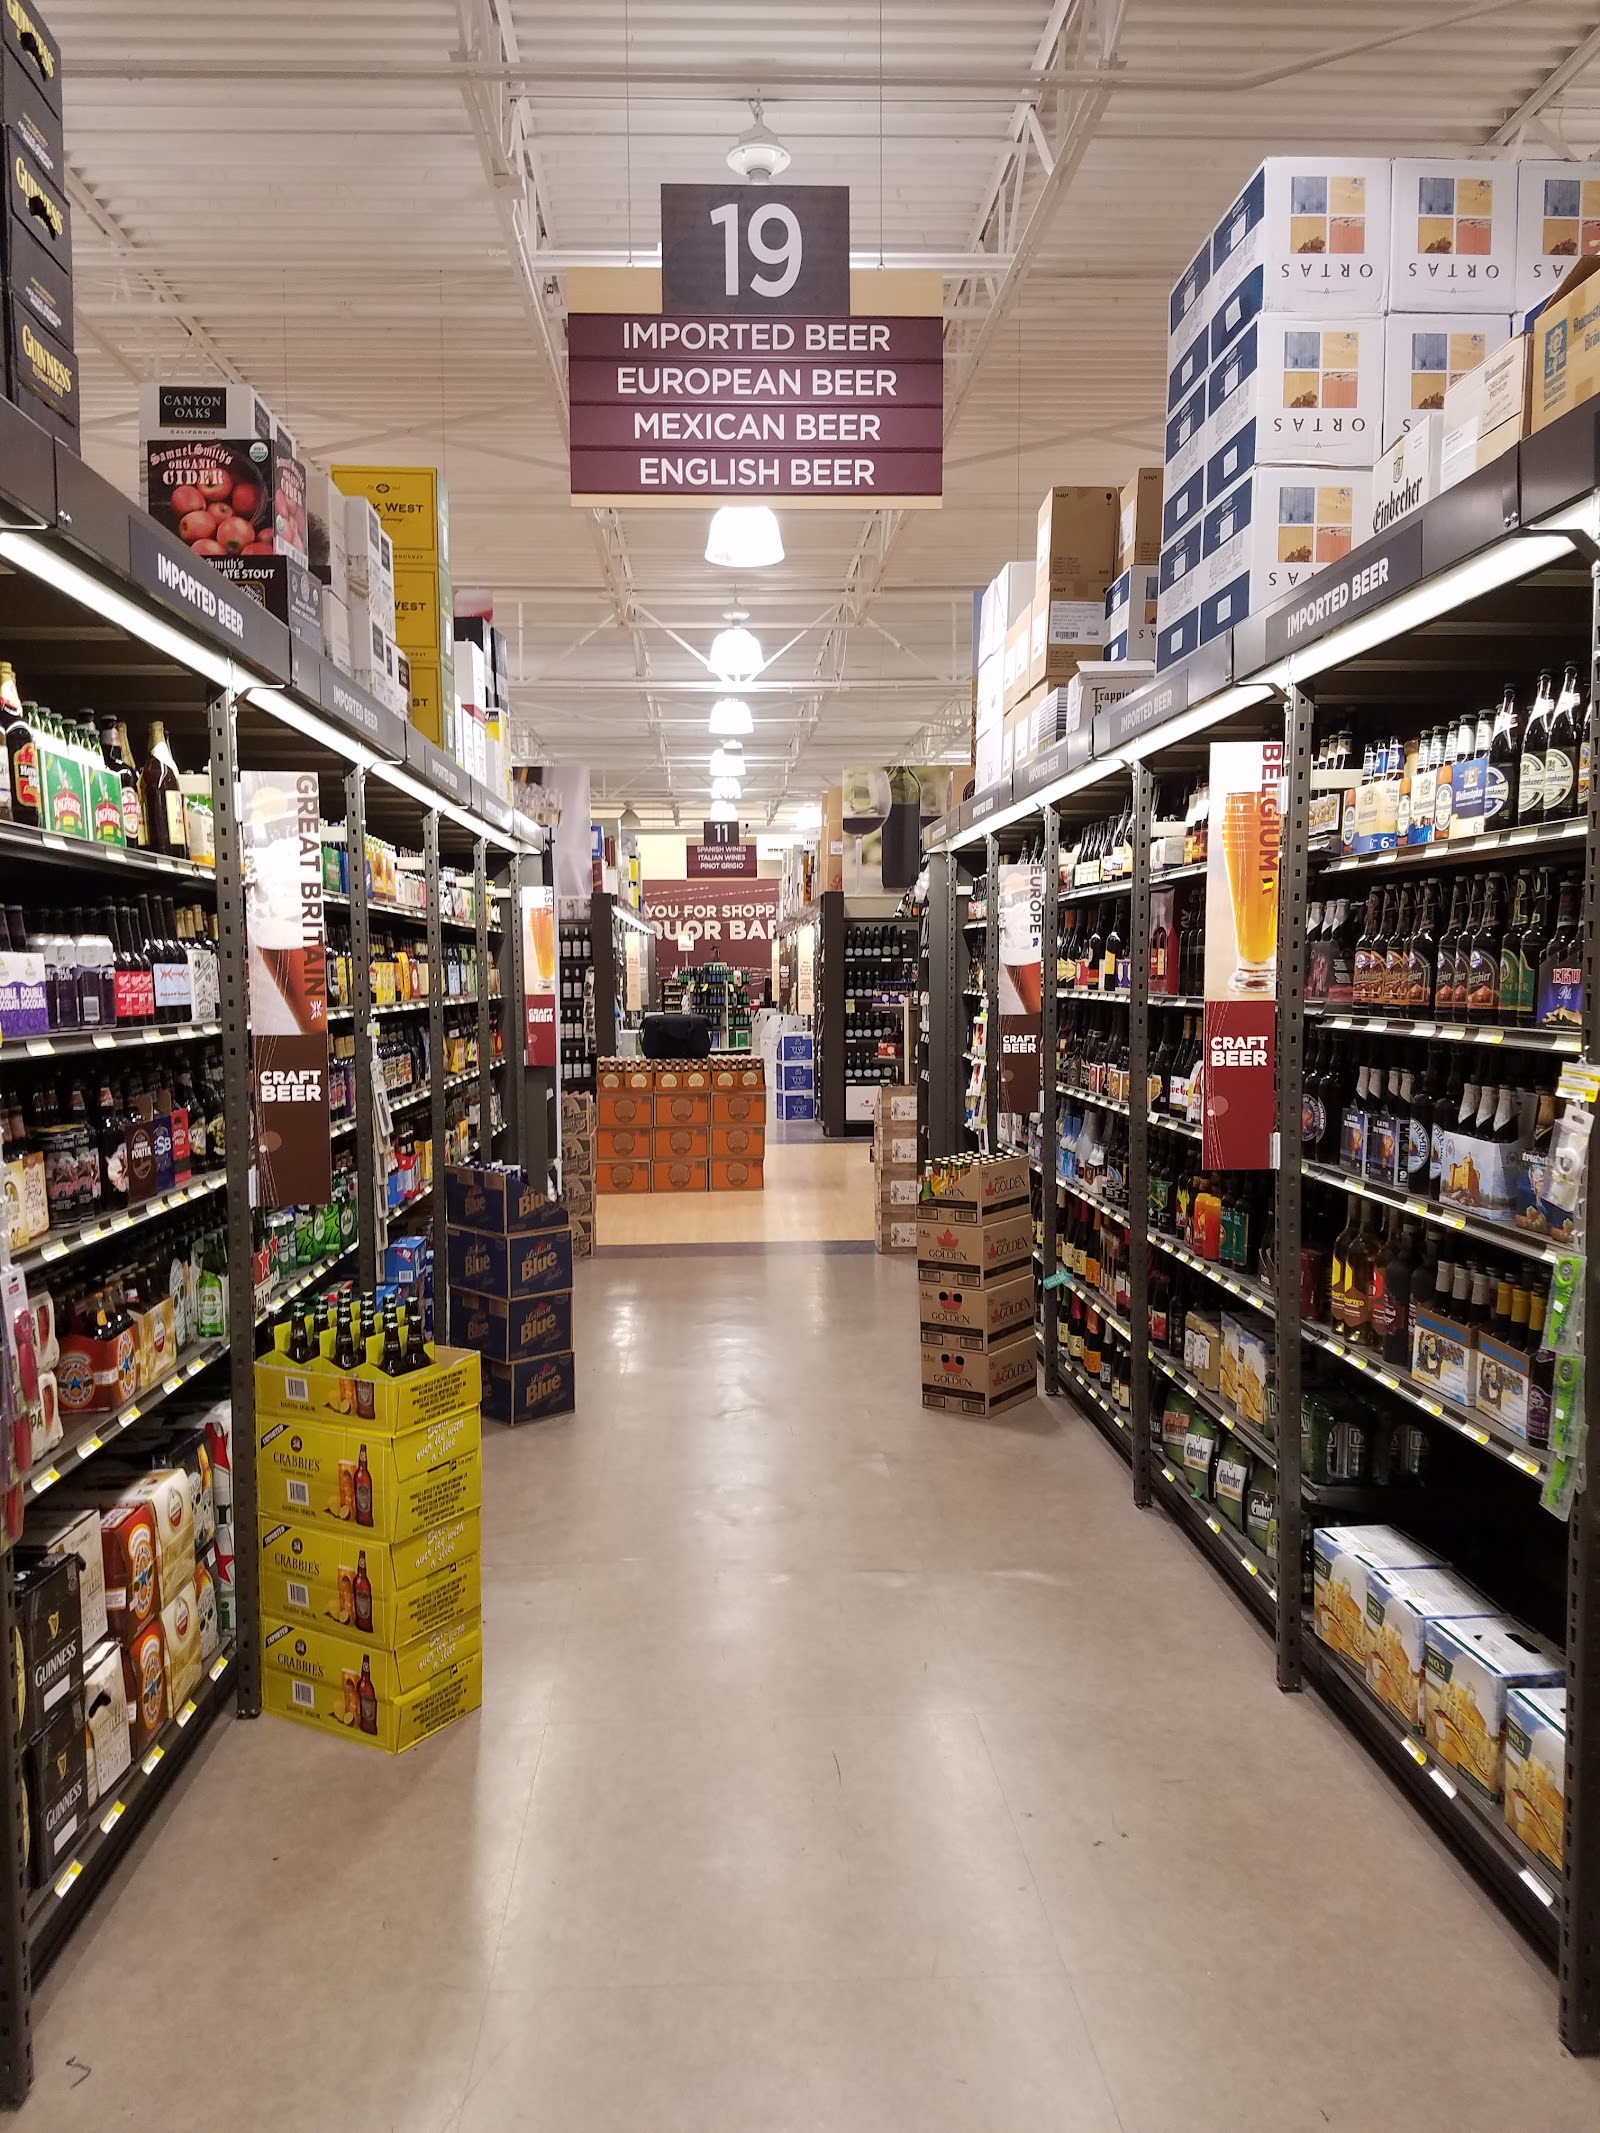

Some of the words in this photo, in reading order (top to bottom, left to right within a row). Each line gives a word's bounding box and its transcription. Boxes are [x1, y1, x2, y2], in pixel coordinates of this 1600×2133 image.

[710, 202, 802, 297] 19
[1281, 263, 1373, 278] ORTAS
[1409, 263, 1500, 278] ORTAS
[623, 322, 795, 351] IMPORTED
[805, 324, 891, 352] BEER
[22, 324, 72, 393] GUINNESS
[616, 367, 801, 396] EUROPEAN
[811, 369, 897, 397] BEER
[163, 394, 222, 406] CANYON
[174, 407, 211, 419] OAKS
[633, 413, 786, 440] MEXICAN
[796, 414, 881, 441] BEER
[1274, 418, 1366, 432] ORTAS
[150, 443, 193, 467] Samuel
[168, 459, 217, 470] ORGANIC
[162, 469, 224, 486] CIDER
[640, 457, 780, 486] ENGLISH
[790, 458, 875, 486] BEER
[385, 501, 424, 514] WEST
[1373, 476, 1423, 534] Einbecker
[242, 569, 275, 579] STOUT
[157, 552, 216, 617] IMPORTED
[218, 597, 244, 639] BEER
[1287, 582, 1348, 639] IMPORTED
[1352, 557, 1389, 602] BEER
[333, 684, 363, 722] IMPORTED
[364, 706, 378, 732] BEER
[1121, 701, 1153, 733] IMPORTED
[1154, 688, 1173, 715] BEER
[1028, 761, 1048, 784] IMPORTED
[1048, 755, 1059, 773] BEER
[1259, 744, 1282, 871] BELGIUM
[296, 774, 320, 872] GREAT
[714, 824, 729, 843] 11
[1380, 837, 1389, 849] 6
[544, 887, 553, 917] ASIA
[1030, 865, 1042, 933] EUROPE
[646, 905, 678, 918] YOU
[684, 905, 717, 918] FOR
[722, 905, 775, 918] SHOPP
[301, 882, 325, 997] BRITAIN
[650, 920, 721, 941] QUOR
[1552, 968, 1581, 984] EKU
[0, 987, 17, 998] OUBLE
[21, 987, 44, 998] DOUBLE
[529, 1014, 553, 1023] BEER
[1002, 1034, 1037, 1043] CRAFT
[1002, 1043, 1037, 1053] BEER
[1211, 1036, 1269, 1050] CRAFT
[1211, 1049, 1268, 1067] BEER
[260, 1070, 321, 1085] CRAFT
[261, 1085, 321, 1102] BEER
[131, 1146, 152, 1160] PORTER
[154, 1135, 171, 1155] SB
[994, 1174, 1026, 1194] GOLDEN
[465, 1192, 486, 1217] Blue
[928, 1249, 967, 1260] GOLDEN
[996, 1236, 1029, 1257] GOLDEN
[464, 1254, 490, 1278] Blue
[521, 1251, 557, 1283] Blue
[931, 1311, 971, 1324] GOLDEN
[1000, 1297, 1031, 1319] GOLDEN
[467, 1321, 489, 1341] Blue
[520, 1313, 557, 1345] Blue
[933, 1374, 972, 1388] GOLDEN
[1001, 1359, 1033, 1382] GOLDEN
[525, 1375, 562, 1407] Blue
[29, 1412, 43, 1429] PA
[262, 1424, 284, 1445] IMPORTED
[416, 1445, 432, 1462] over
[447, 1419, 464, 1437] with
[438, 1437, 457, 1457] slice
[1186, 1441, 1208, 1460] Einbecker
[273, 1451, 320, 1472] CRABBIE'S
[1218, 1466, 1241, 1489] Einbecker
[264, 1525, 285, 1547] IMPORTED
[415, 1552, 432, 1569] over
[446, 1521, 464, 1540] with
[438, 1542, 455, 1562] slice
[274, 1553, 320, 1576] CRABBIE'S
[266, 1626, 289, 1648] IMPORTED
[35, 1639, 77, 1688] GUINNESS
[277, 1653, 324, 1677] CRABBIE'S
[1427, 1656, 1446, 1674] NO.1
[1508, 1730, 1525, 1751] NO.1
[46, 1778, 82, 1832] GUINNESS
